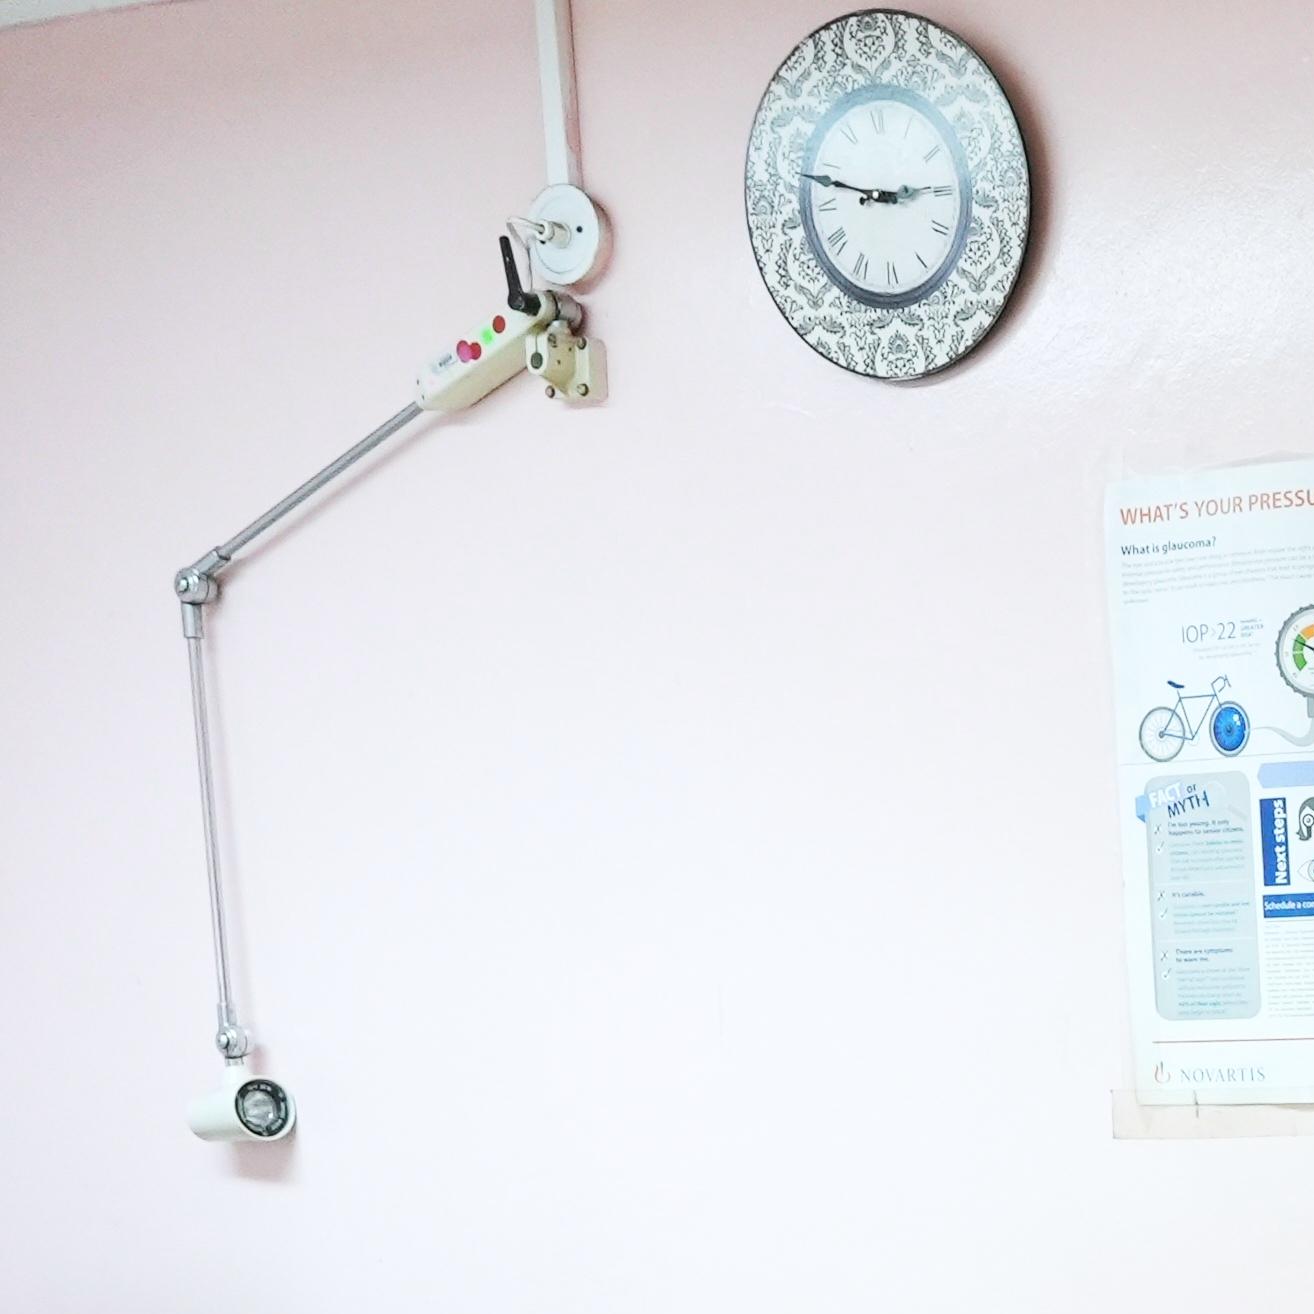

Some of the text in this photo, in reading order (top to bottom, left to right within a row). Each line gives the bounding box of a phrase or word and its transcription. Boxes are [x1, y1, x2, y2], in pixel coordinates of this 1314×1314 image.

[1120, 502, 1189, 525] WHAT'S
[1194, 496, 1243, 517] YOUR
[1121, 544, 1150, 555] What
[1152, 543, 1160, 553] is
[1162, 536, 1217, 555] glaucoma?
[1148, 782, 1197, 809] FACT or
[1168, 790, 1210, 818] MYTH
[1274, 799, 1288, 883] Next steps
[1265, 901, 1296, 910] Schedule
[1180, 1067, 1265, 1082] NOVARTIS
